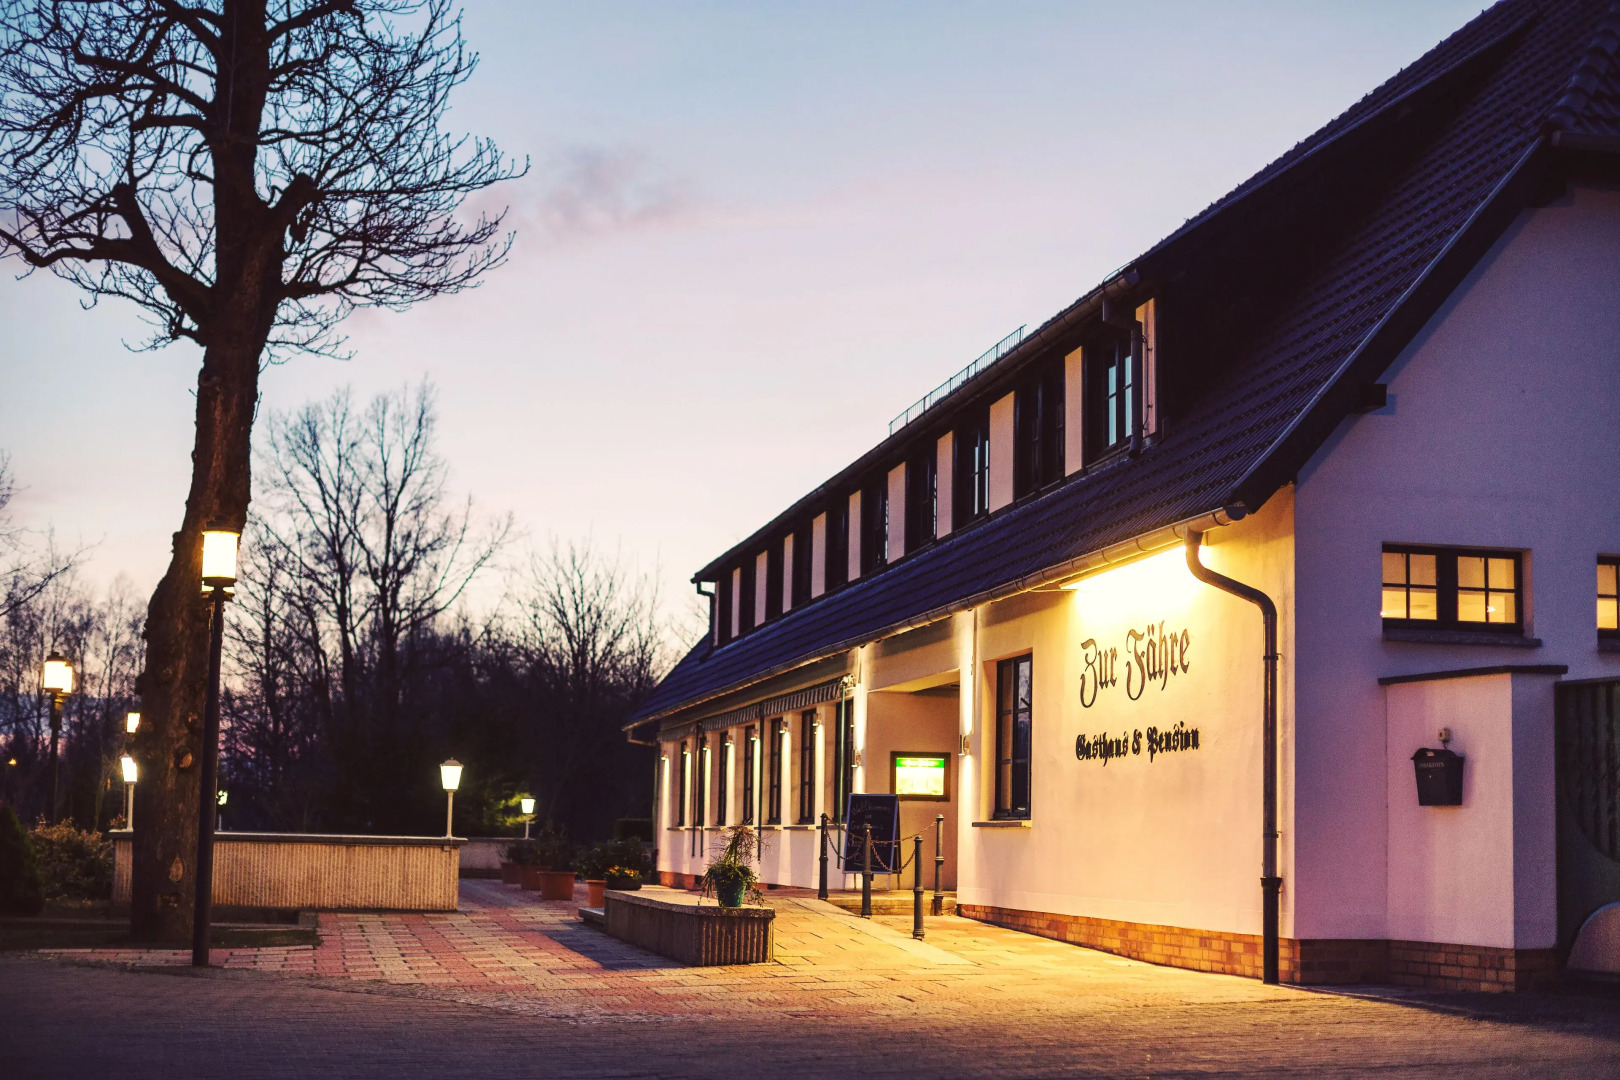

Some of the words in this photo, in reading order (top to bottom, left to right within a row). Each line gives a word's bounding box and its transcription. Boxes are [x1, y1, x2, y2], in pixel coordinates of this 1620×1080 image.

[1080, 638, 1118, 708] Zur
[1126, 620, 1190, 700] Fähre
[1075, 731, 1129, 767] Gasthaus
[1132, 728, 1142, 755] &
[1146, 720, 1200, 763] Pension
